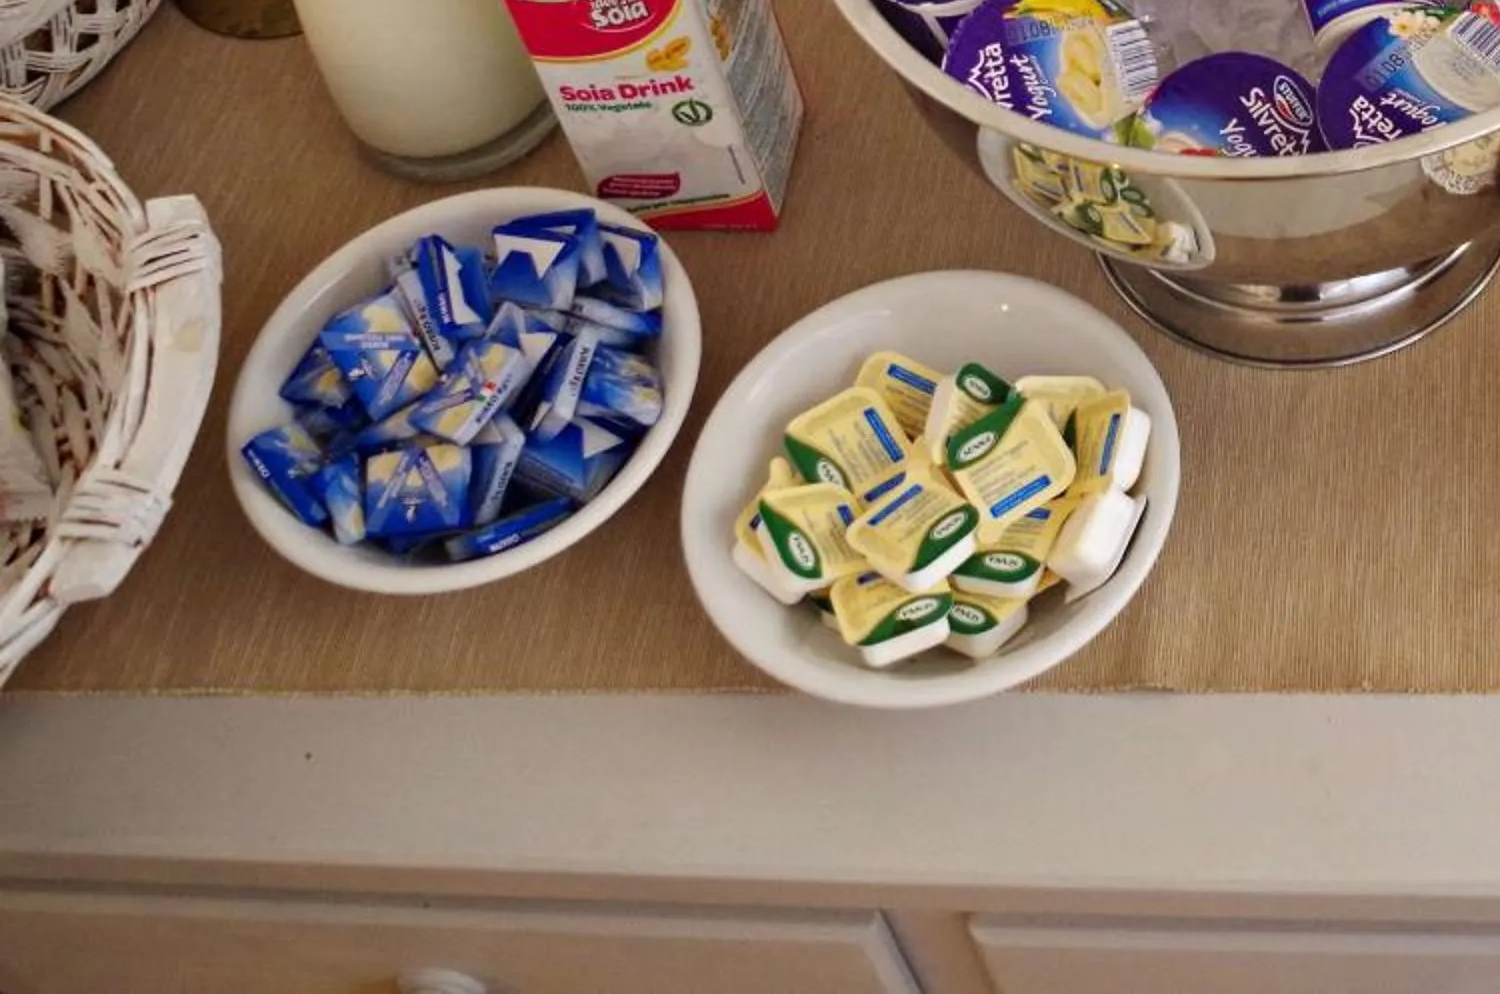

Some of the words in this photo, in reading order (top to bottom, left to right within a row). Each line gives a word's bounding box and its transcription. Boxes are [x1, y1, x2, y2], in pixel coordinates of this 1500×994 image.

[559, 84, 616, 102] Soia
[618, 74, 695, 100] Drink
[1010, 54, 1053, 120] Yogurt
[1240, 86, 1299, 157] Silvret
